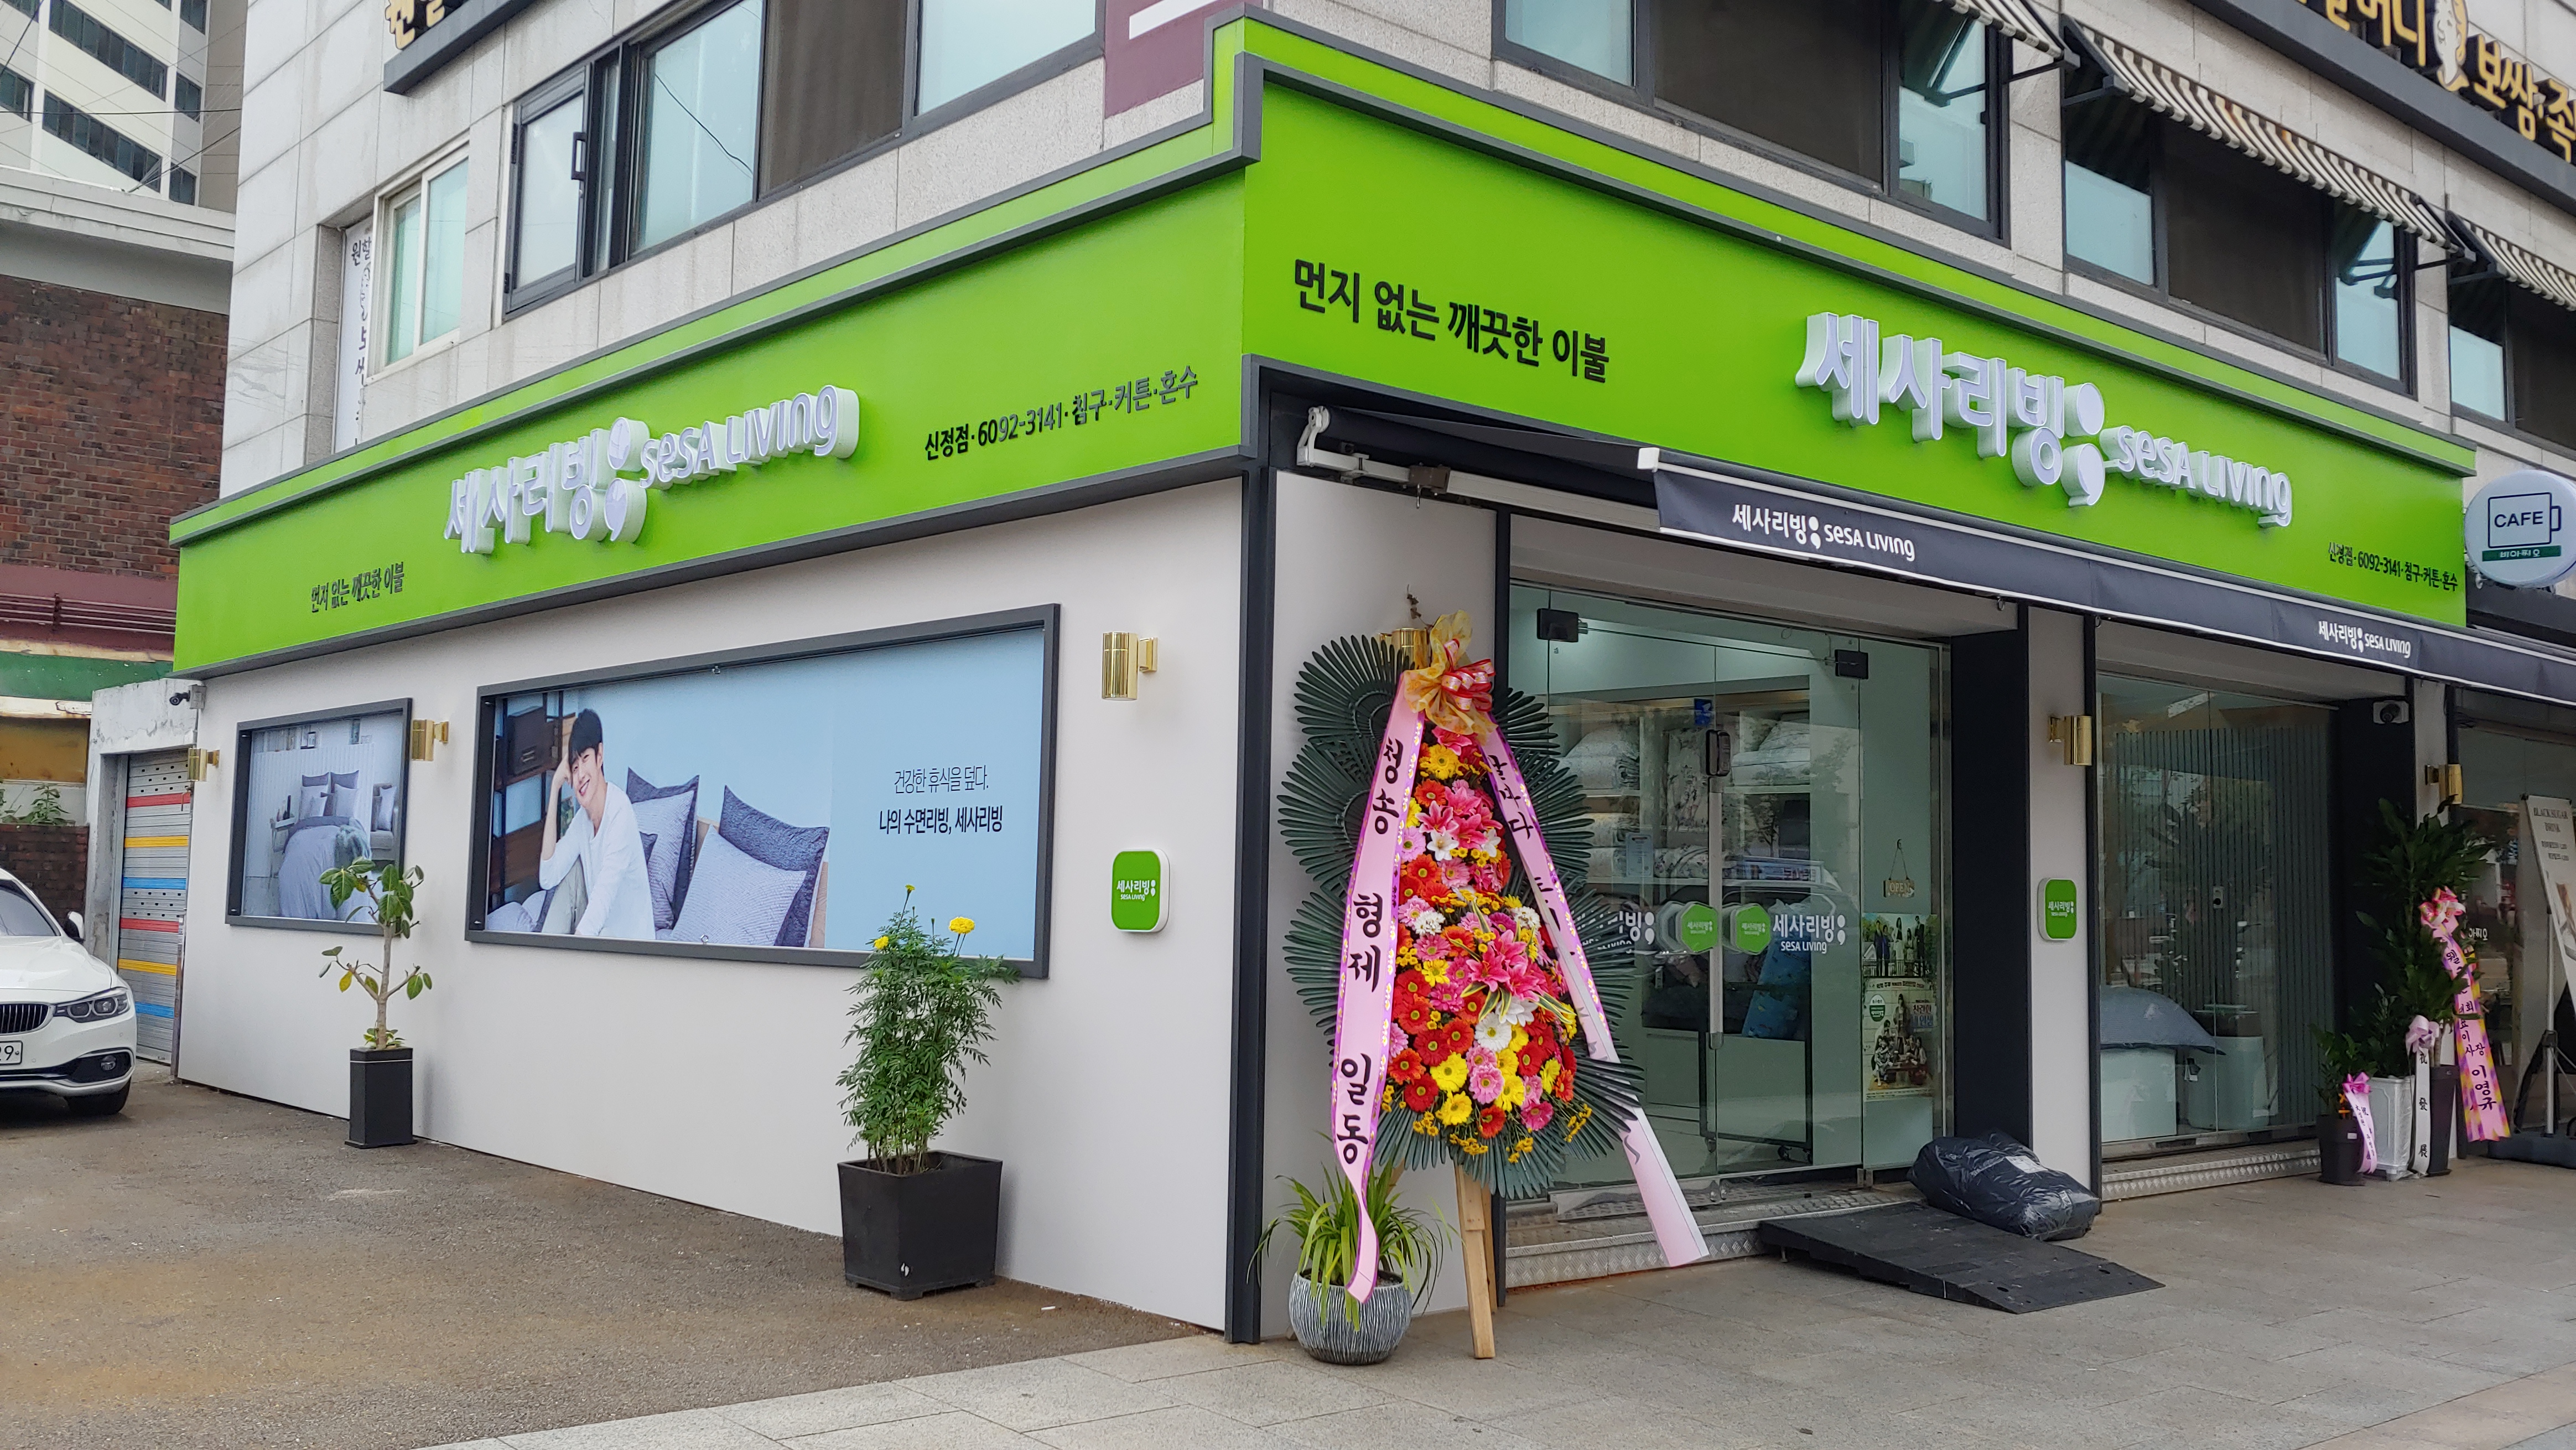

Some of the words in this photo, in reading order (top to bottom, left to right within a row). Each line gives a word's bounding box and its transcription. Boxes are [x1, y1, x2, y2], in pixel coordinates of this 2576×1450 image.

[1295, 259, 1360, 323] 먼지
[1374, 281, 1440, 341] 없는
[1448, 302, 1543, 367] 깨끗한
[1552, 329, 1609, 383] 이불
[1795, 312, 2065, 487] 세사리빙
[444, 429, 615, 554] 세사리빙
[1732, 504, 1807, 545] 세사리빙
[2494, 511, 2543, 527] CAFE
[311, 582, 329, 613] 먼지
[331, 578, 350, 609] 없는
[351, 568, 382, 602] 깨끗한
[384, 561, 404, 594] 이불
[2318, 620, 2357, 650] 세사리빙
[894, 768, 927, 794] 건강한
[928, 767, 962, 793] 휴식을
[964, 765, 989, 791] 덮다.
[1372, 738, 1404, 835] 청송
[879, 809, 901, 835] 나의
[903, 807, 952, 835] 수면리빙,
[955, 805, 1003, 833] 세사리빙
[1116, 879, 1150, 895] 세사리빙
[1889, 883, 1910, 892] OPEN
[2048, 901, 2070, 913] 세사리빙
[1348, 892, 1383, 992] 형제
[1773, 914, 1835, 942] 세사리빙
[1336, 1053, 1372, 1164] 일동
